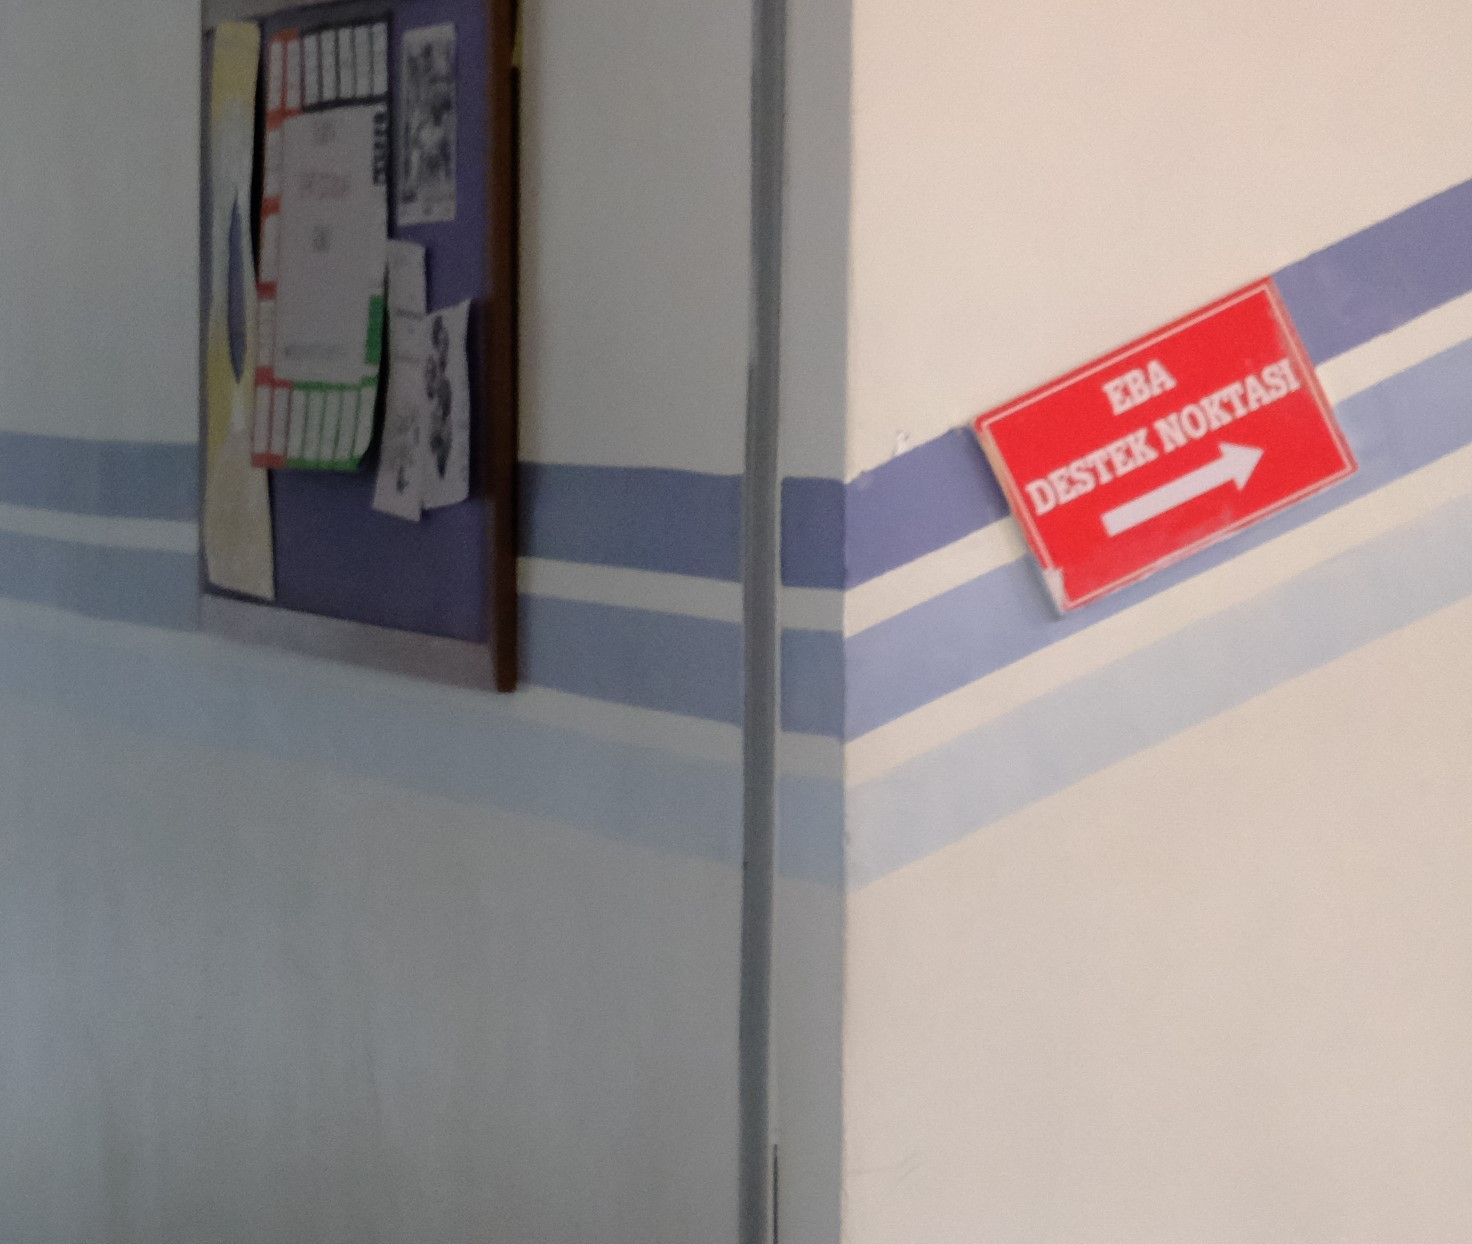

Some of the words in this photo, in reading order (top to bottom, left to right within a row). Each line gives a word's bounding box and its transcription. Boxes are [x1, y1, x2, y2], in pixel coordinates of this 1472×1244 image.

[1025, 427, 1159, 517] DESTEK
[1153, 356, 1303, 454] NOKTASI
[1101, 359, 1178, 416] EBA
